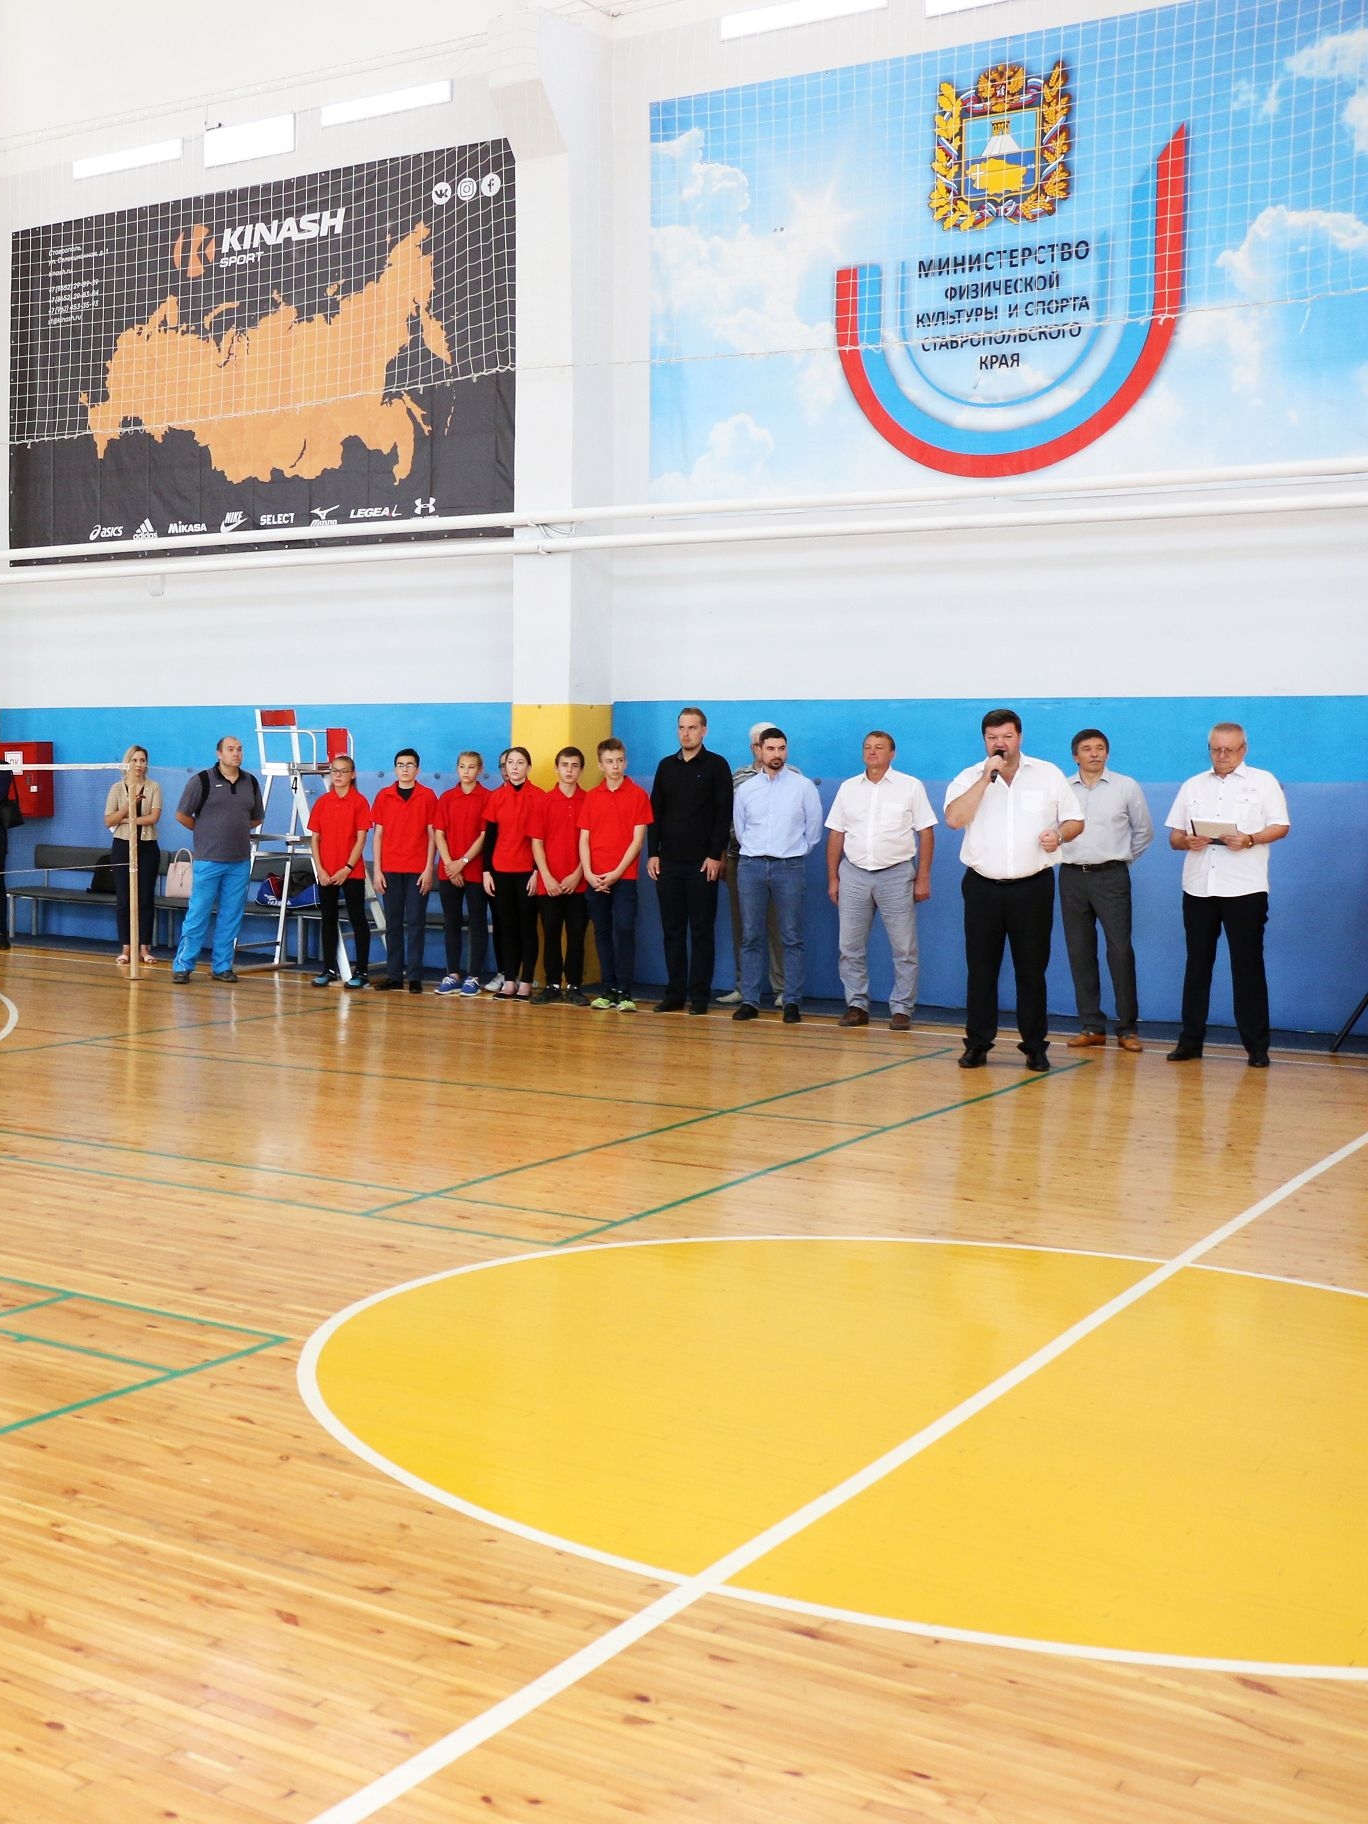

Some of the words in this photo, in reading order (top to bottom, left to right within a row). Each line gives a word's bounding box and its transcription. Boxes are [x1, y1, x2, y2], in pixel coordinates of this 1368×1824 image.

[221, 208, 345, 253] KINASH
[220, 251, 264, 268] SPORT
[918, 240, 1090, 279] МИНИСТЕРСТВО
[944, 270, 1060, 301] ФИЗИЧЕСКОЙ
[916, 305, 998, 328] КУЛЬТУРЫ
[1008, 304, 1019, 318] И
[1024, 296, 1090, 316] СПОРТА
[921, 322, 1081, 352] СТАВРОПОЛЬСКОГО
[979, 353, 1020, 370] КРАЯ
[224, 511, 243, 523] NIKE
[260, 512, 294, 526] SELECT
[349, 507, 389, 519] LEGEA
[133, 532, 158, 540] adidas
[292, 777, 298, 794] 4
